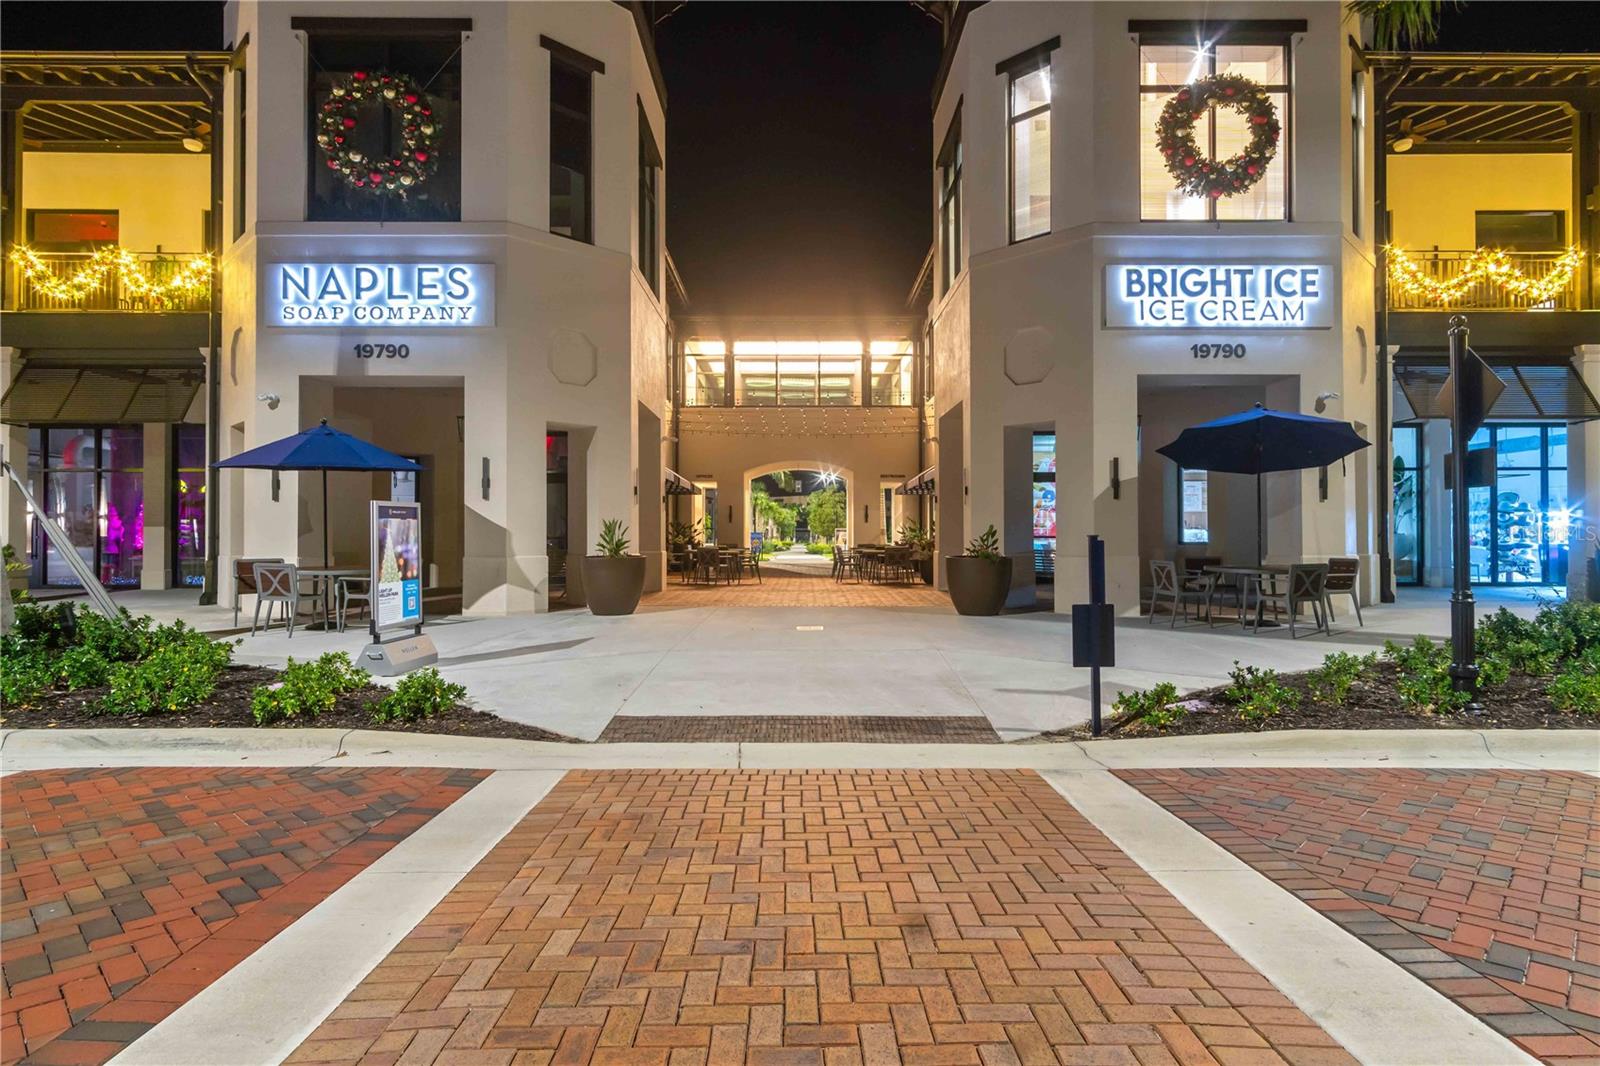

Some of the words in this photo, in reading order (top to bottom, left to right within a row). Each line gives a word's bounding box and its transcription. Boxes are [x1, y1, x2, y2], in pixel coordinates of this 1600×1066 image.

[281, 267, 470, 300] NAPLES
[1126, 268, 1254, 298] BRIGHT
[1265, 268, 1319, 298] ICE
[283, 306, 345, 320] SOAP
[353, 306, 472, 320] COMPANY
[1140, 299, 1185, 321] ICE
[1200, 299, 1304, 321] CREAM
[353, 343, 410, 359] 19790
[1190, 343, 1247, 359] 19790
